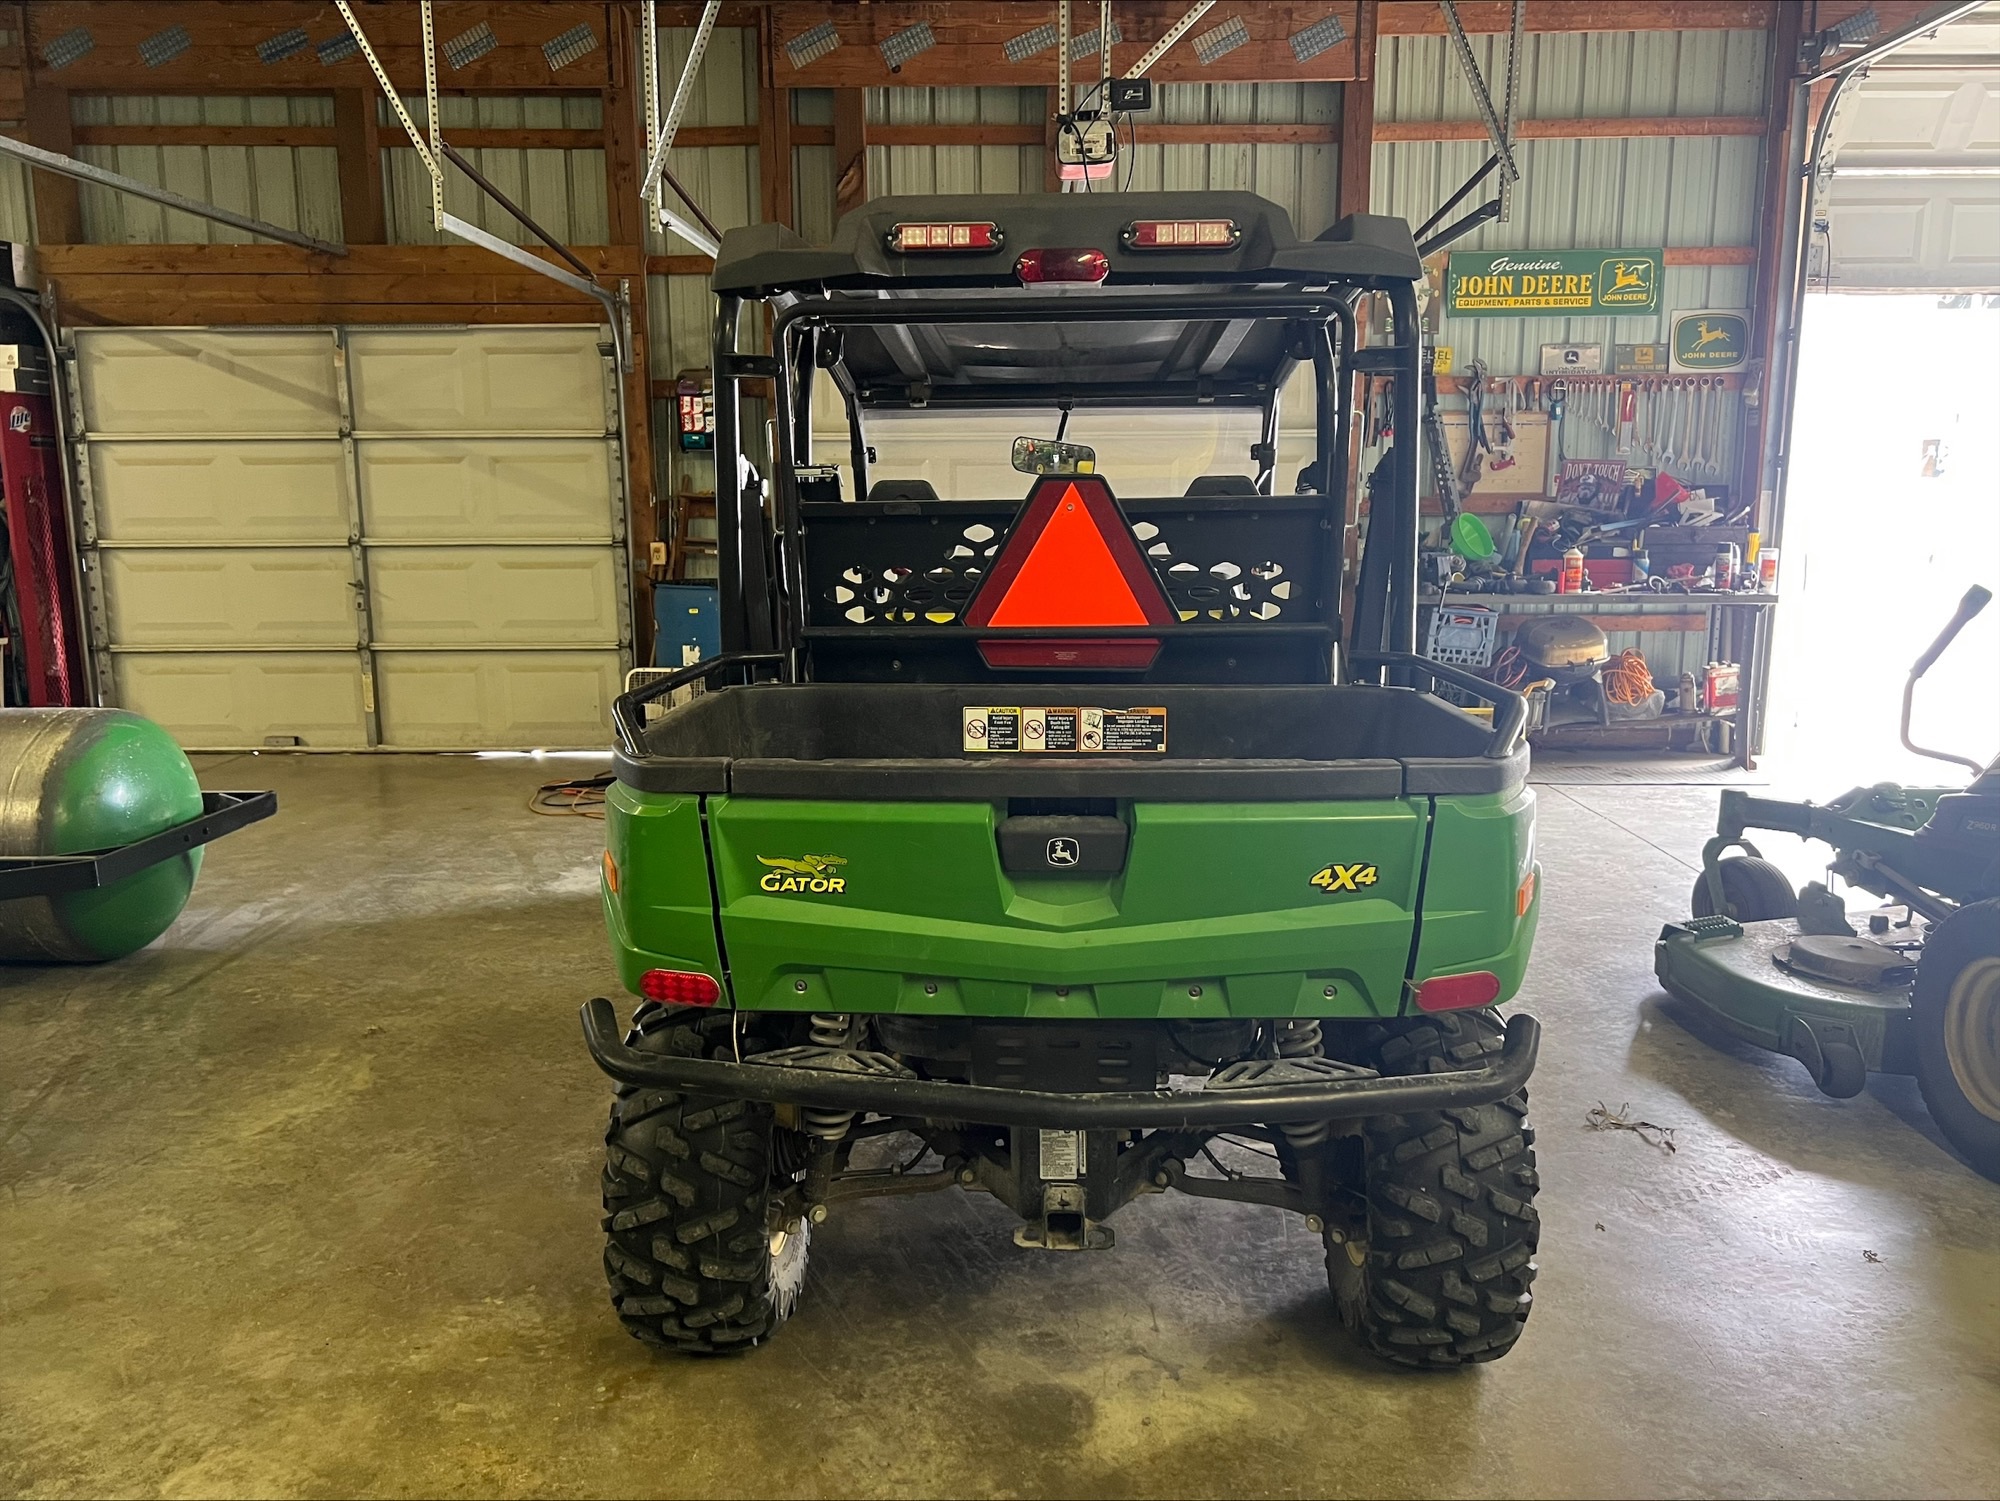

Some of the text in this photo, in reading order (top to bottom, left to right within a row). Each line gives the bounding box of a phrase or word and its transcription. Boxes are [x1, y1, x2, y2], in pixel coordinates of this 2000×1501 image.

[1489, 256, 1561, 275] Genuine
[1457, 274, 1593, 296] JOHN DEERE
[1458, 299, 1511, 308] EQUIPMENT,
[1513, 298, 1542, 306] PARTS
[1553, 297, 1590, 305] SERVICE
[1623, 293, 1648, 301] DEERE
[1593, 464, 1621, 482] TOUCH
[760, 873, 846, 893] GATOR
[1310, 864, 1378, 891] 4X4
